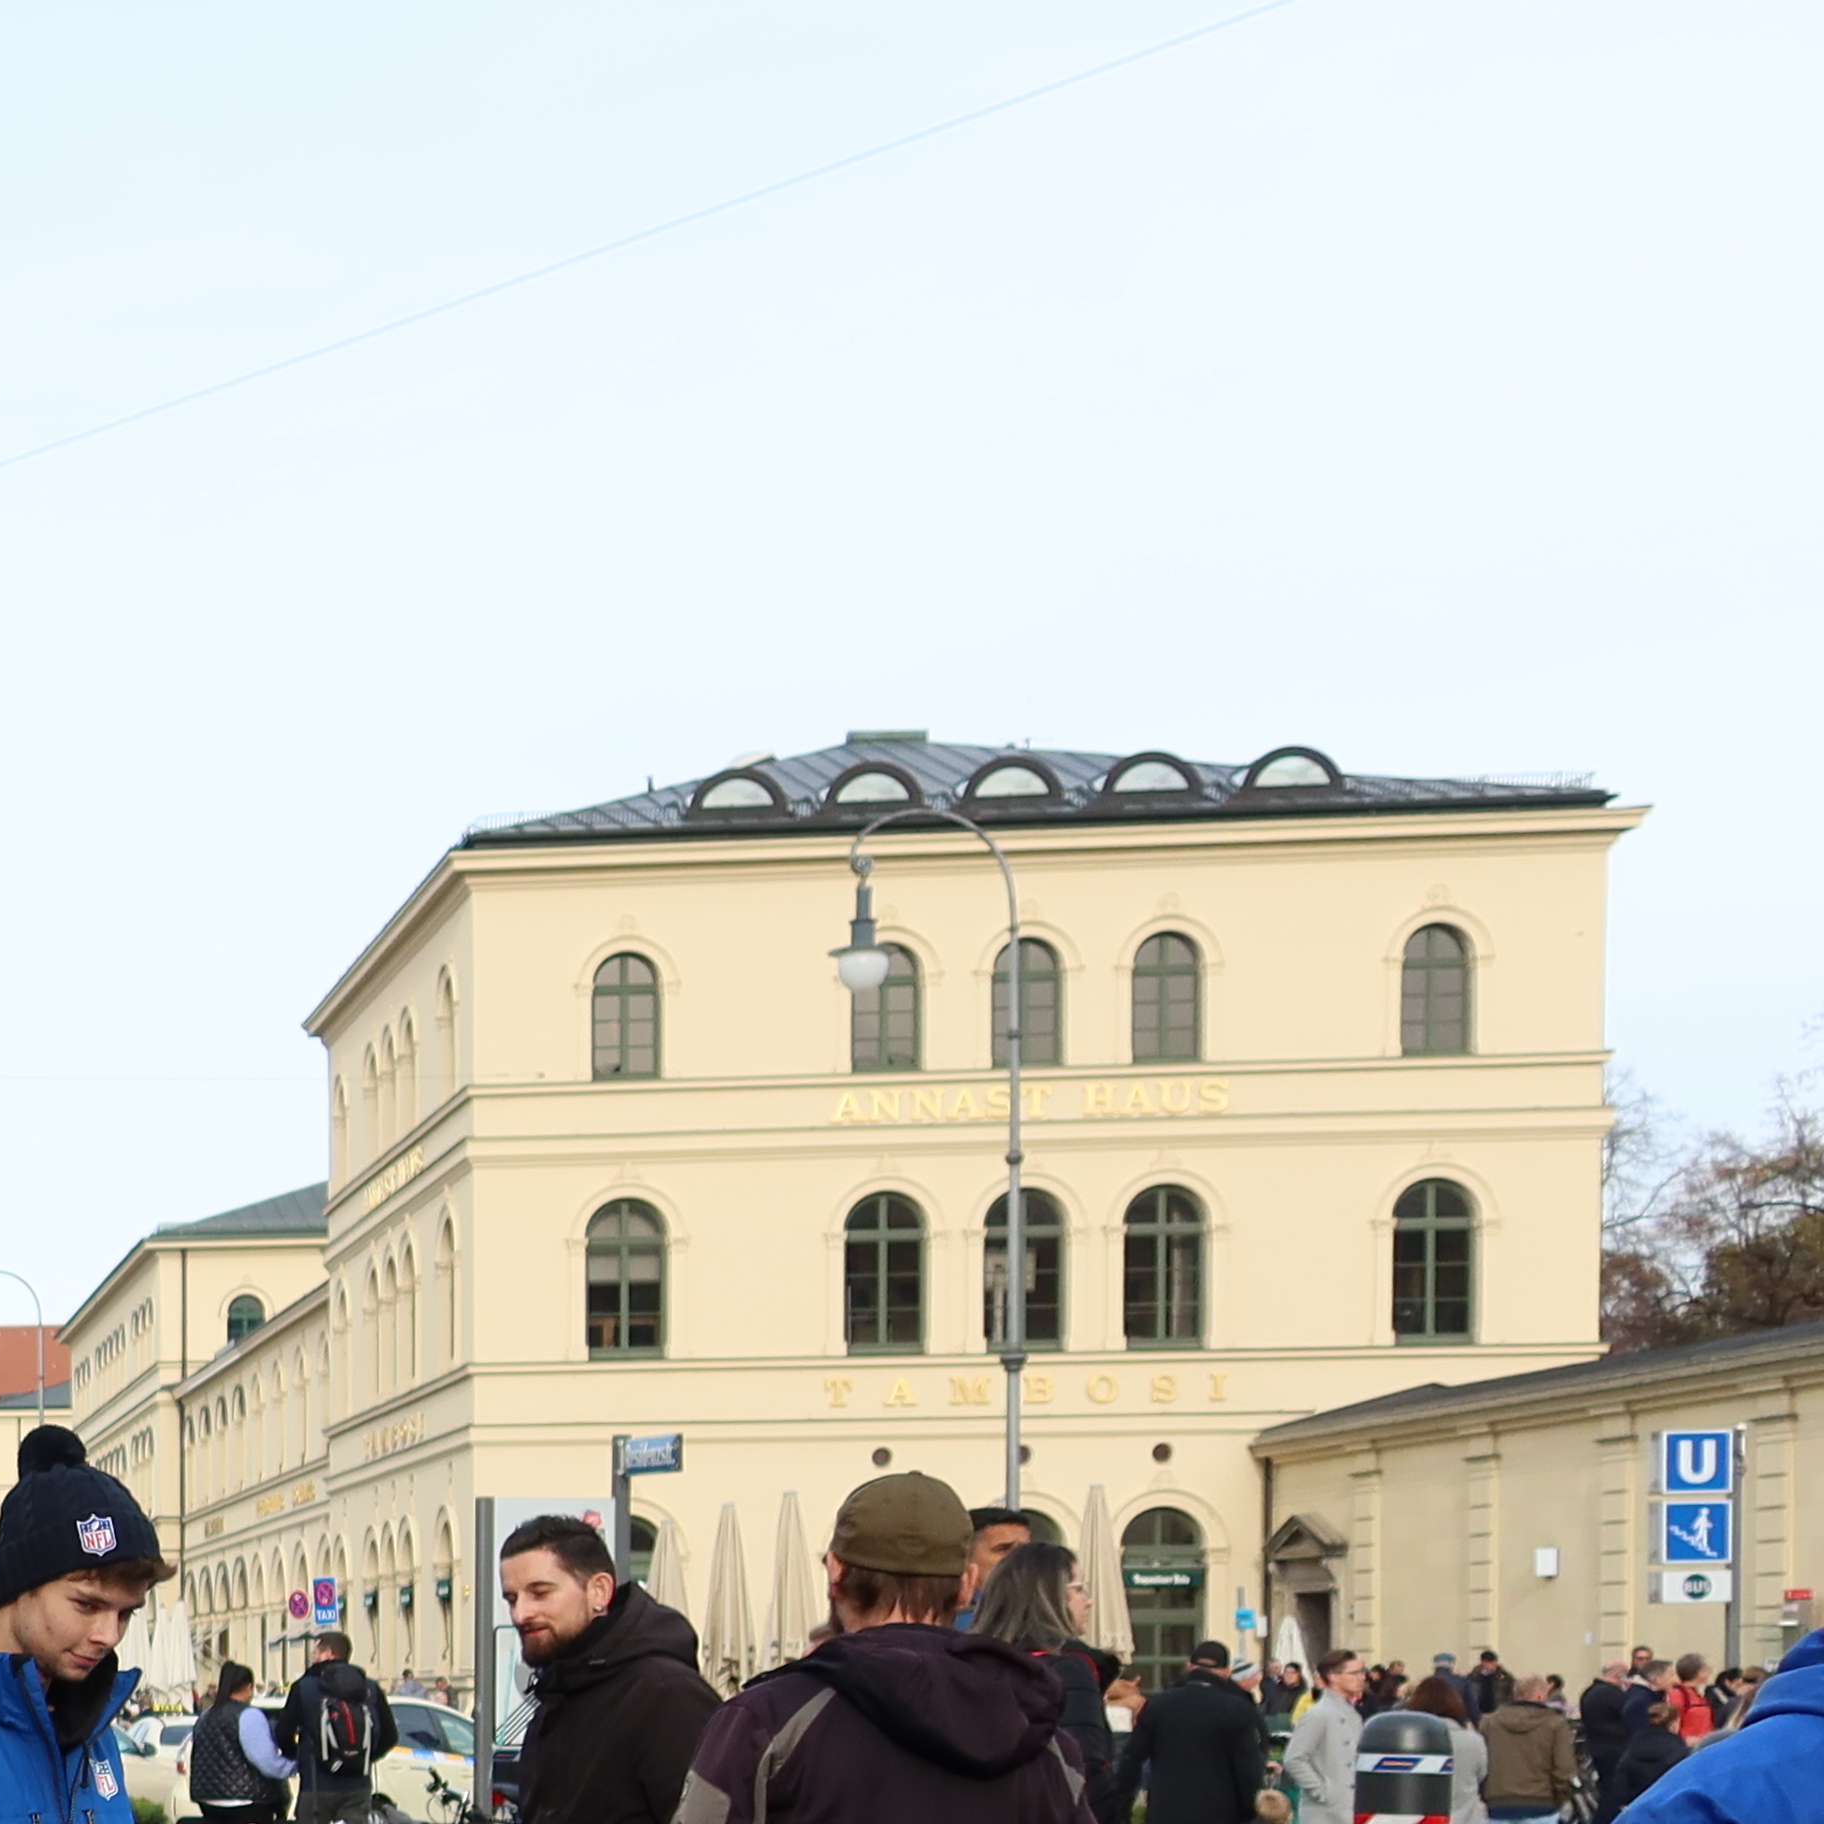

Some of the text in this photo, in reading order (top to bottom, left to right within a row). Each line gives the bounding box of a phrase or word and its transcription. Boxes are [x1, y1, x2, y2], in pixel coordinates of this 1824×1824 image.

[830, 1080, 1232, 1123] ANNAST HAUS
[824, 1371, 1230, 1408] TAMBOSI
[1677, 1439, 1717, 1484] U
[85, 1532, 113, 1549] NFL
[1684, 1579, 1710, 1594] BUS
[317, 1609, 336, 1620] TAXI
